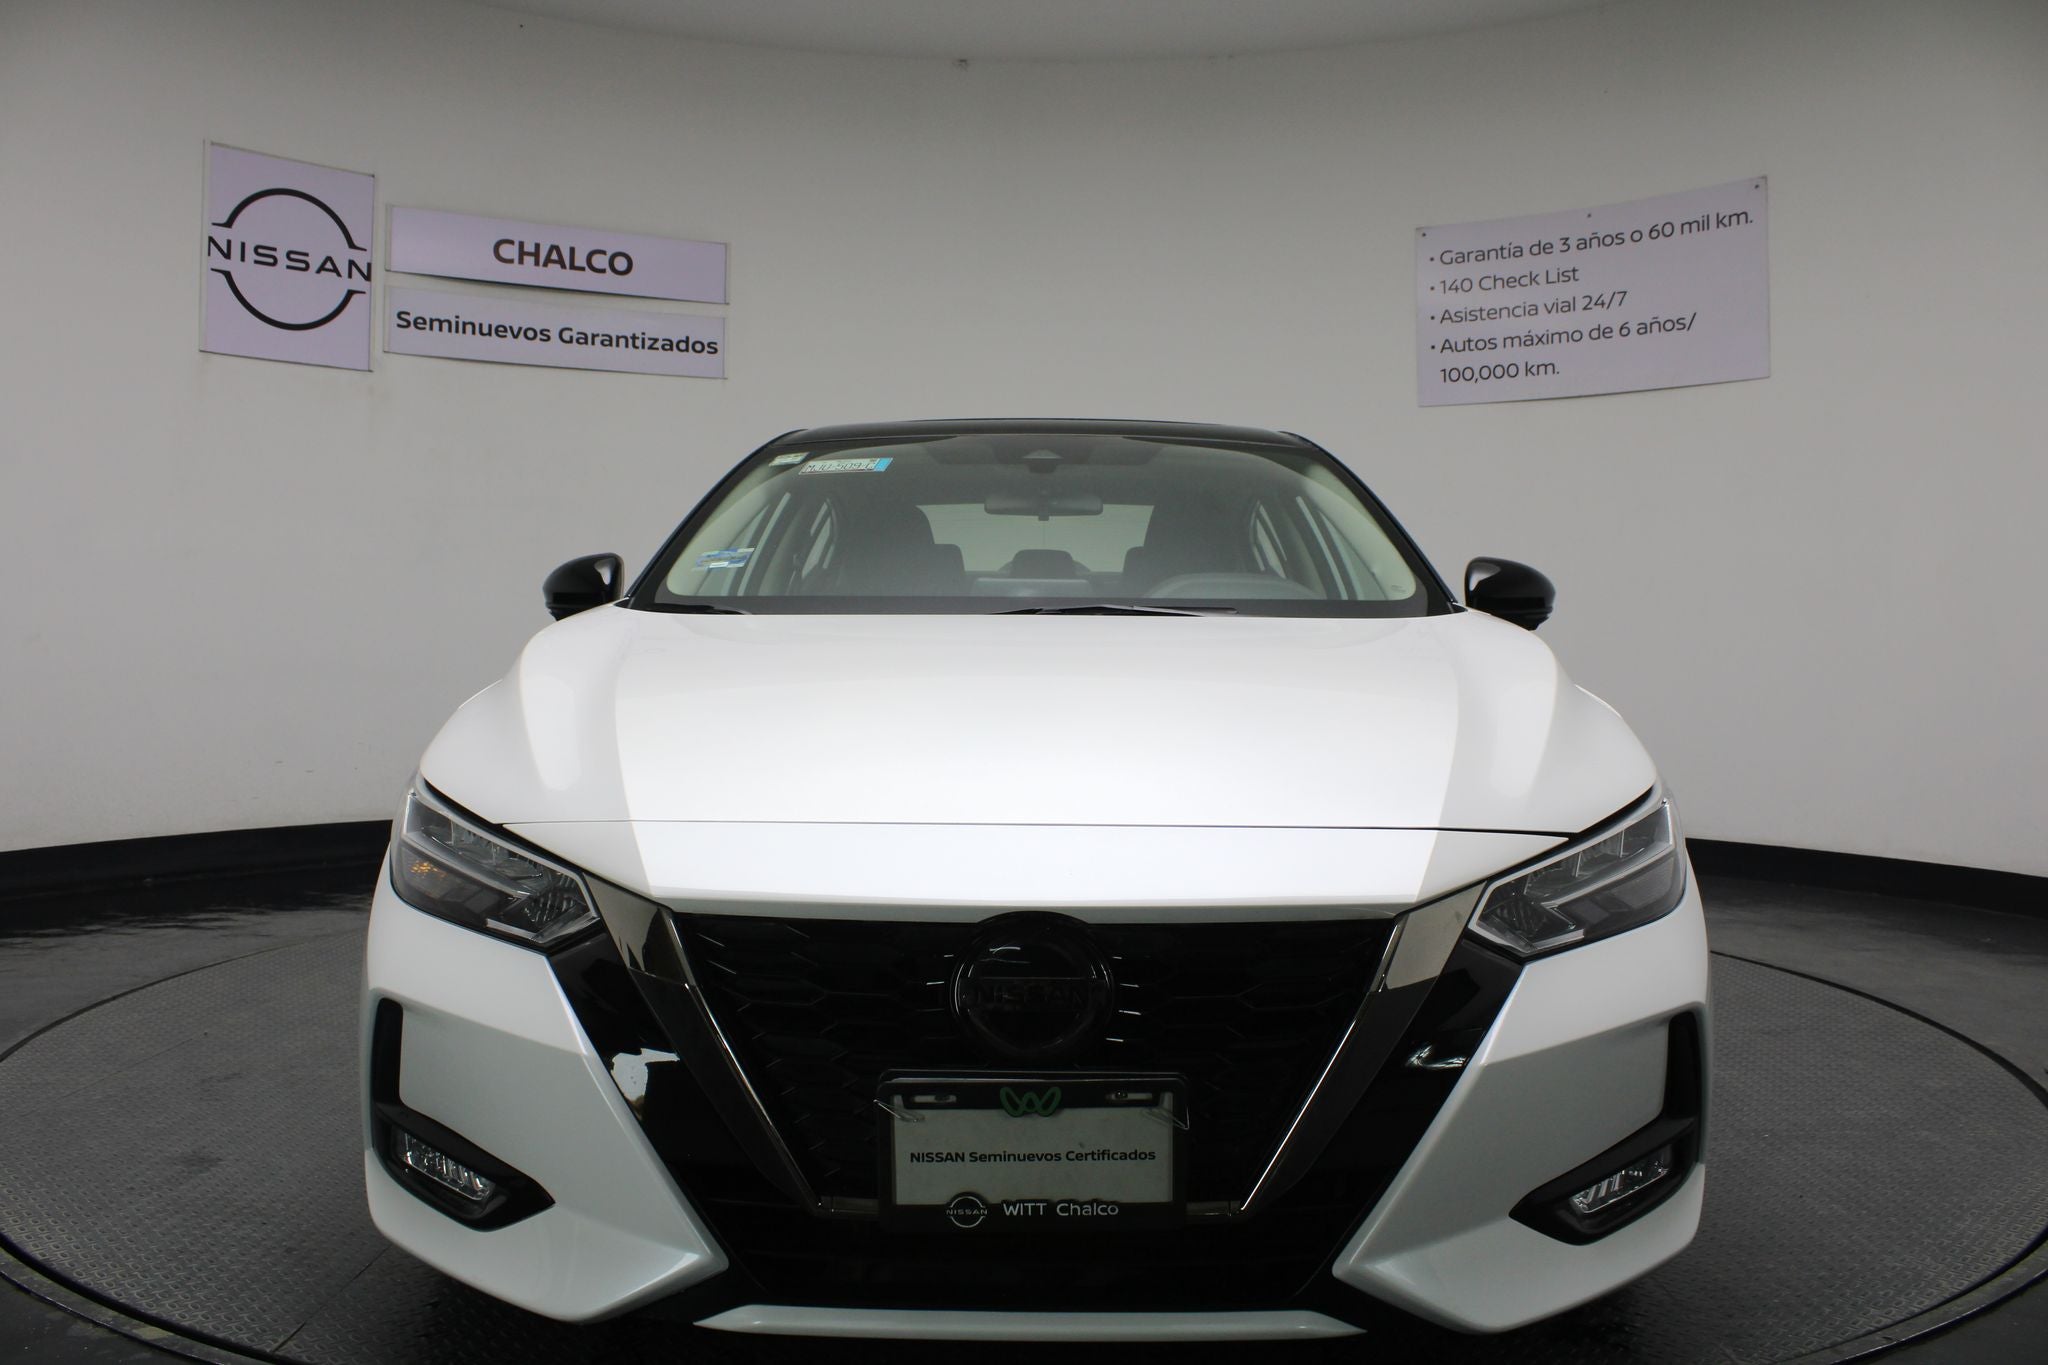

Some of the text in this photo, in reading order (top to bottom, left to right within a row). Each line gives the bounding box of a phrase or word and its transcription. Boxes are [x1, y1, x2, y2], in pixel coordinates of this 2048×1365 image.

[1439, 210, 1753, 265] Garantía de 3 años o 60 mil km.
[207, 235, 372, 283] NISSAN
[492, 238, 634, 276] CHALCO
[1440, 266, 1580, 295] 140 Check List
[1440, 290, 1628, 324] Asistencia vial 24/7
[396, 310, 719, 355] Seminuevos Garantizados
[1440, 312, 1697, 354] Autos máximo de 6 años/
[1440, 360, 1560, 384] 100,000 km.
[909, 1148, 1156, 1163] NISSAN Seminuevos Certificados
[946, 1208, 988, 1216] NISSAN
[1003, 1202, 1119, 1216] WITT Chalco
